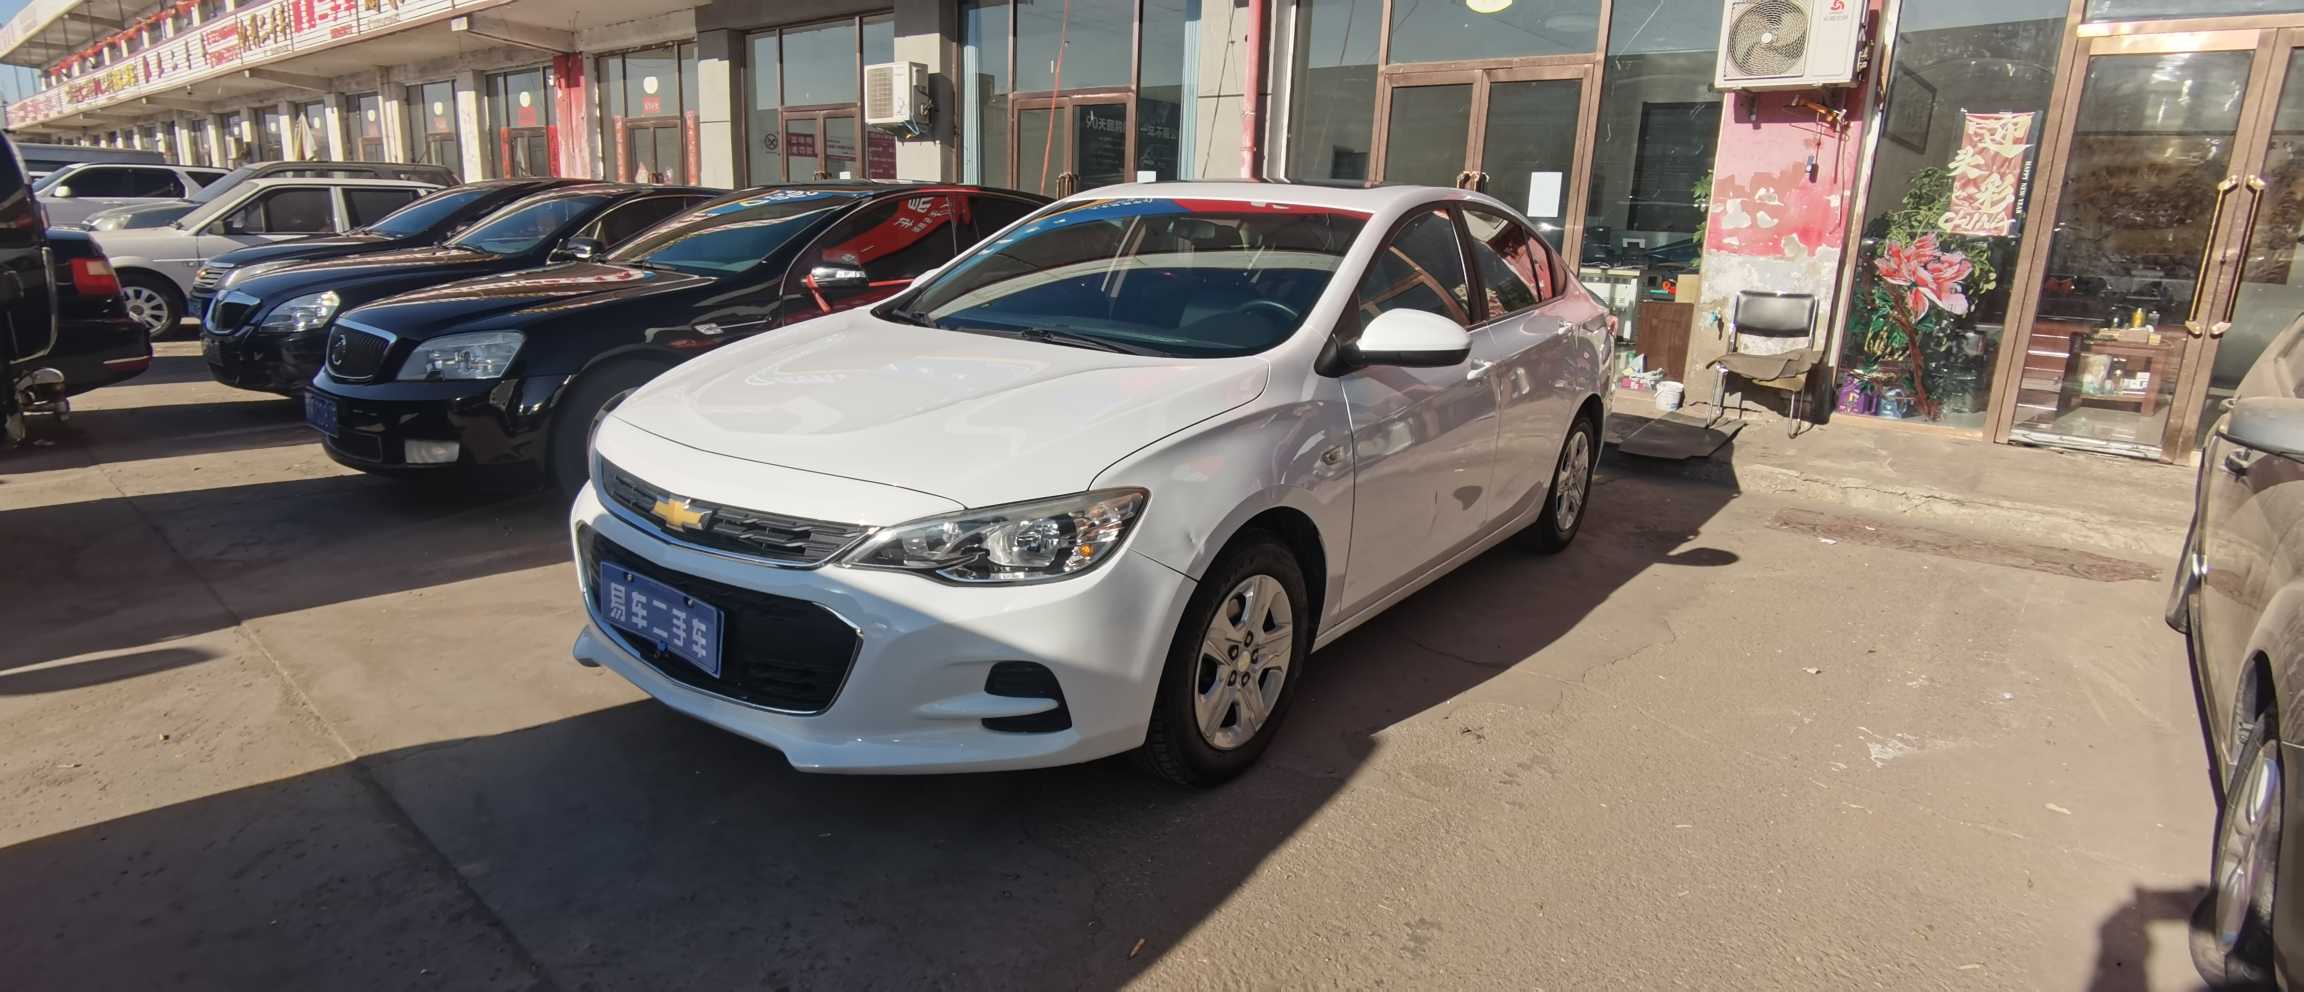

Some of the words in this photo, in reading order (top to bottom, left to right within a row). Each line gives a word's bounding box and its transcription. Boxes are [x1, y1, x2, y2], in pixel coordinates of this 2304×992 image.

[2021, 160, 2033, 180] HAPPY
[610, 581, 707, 658] 易车二手车
